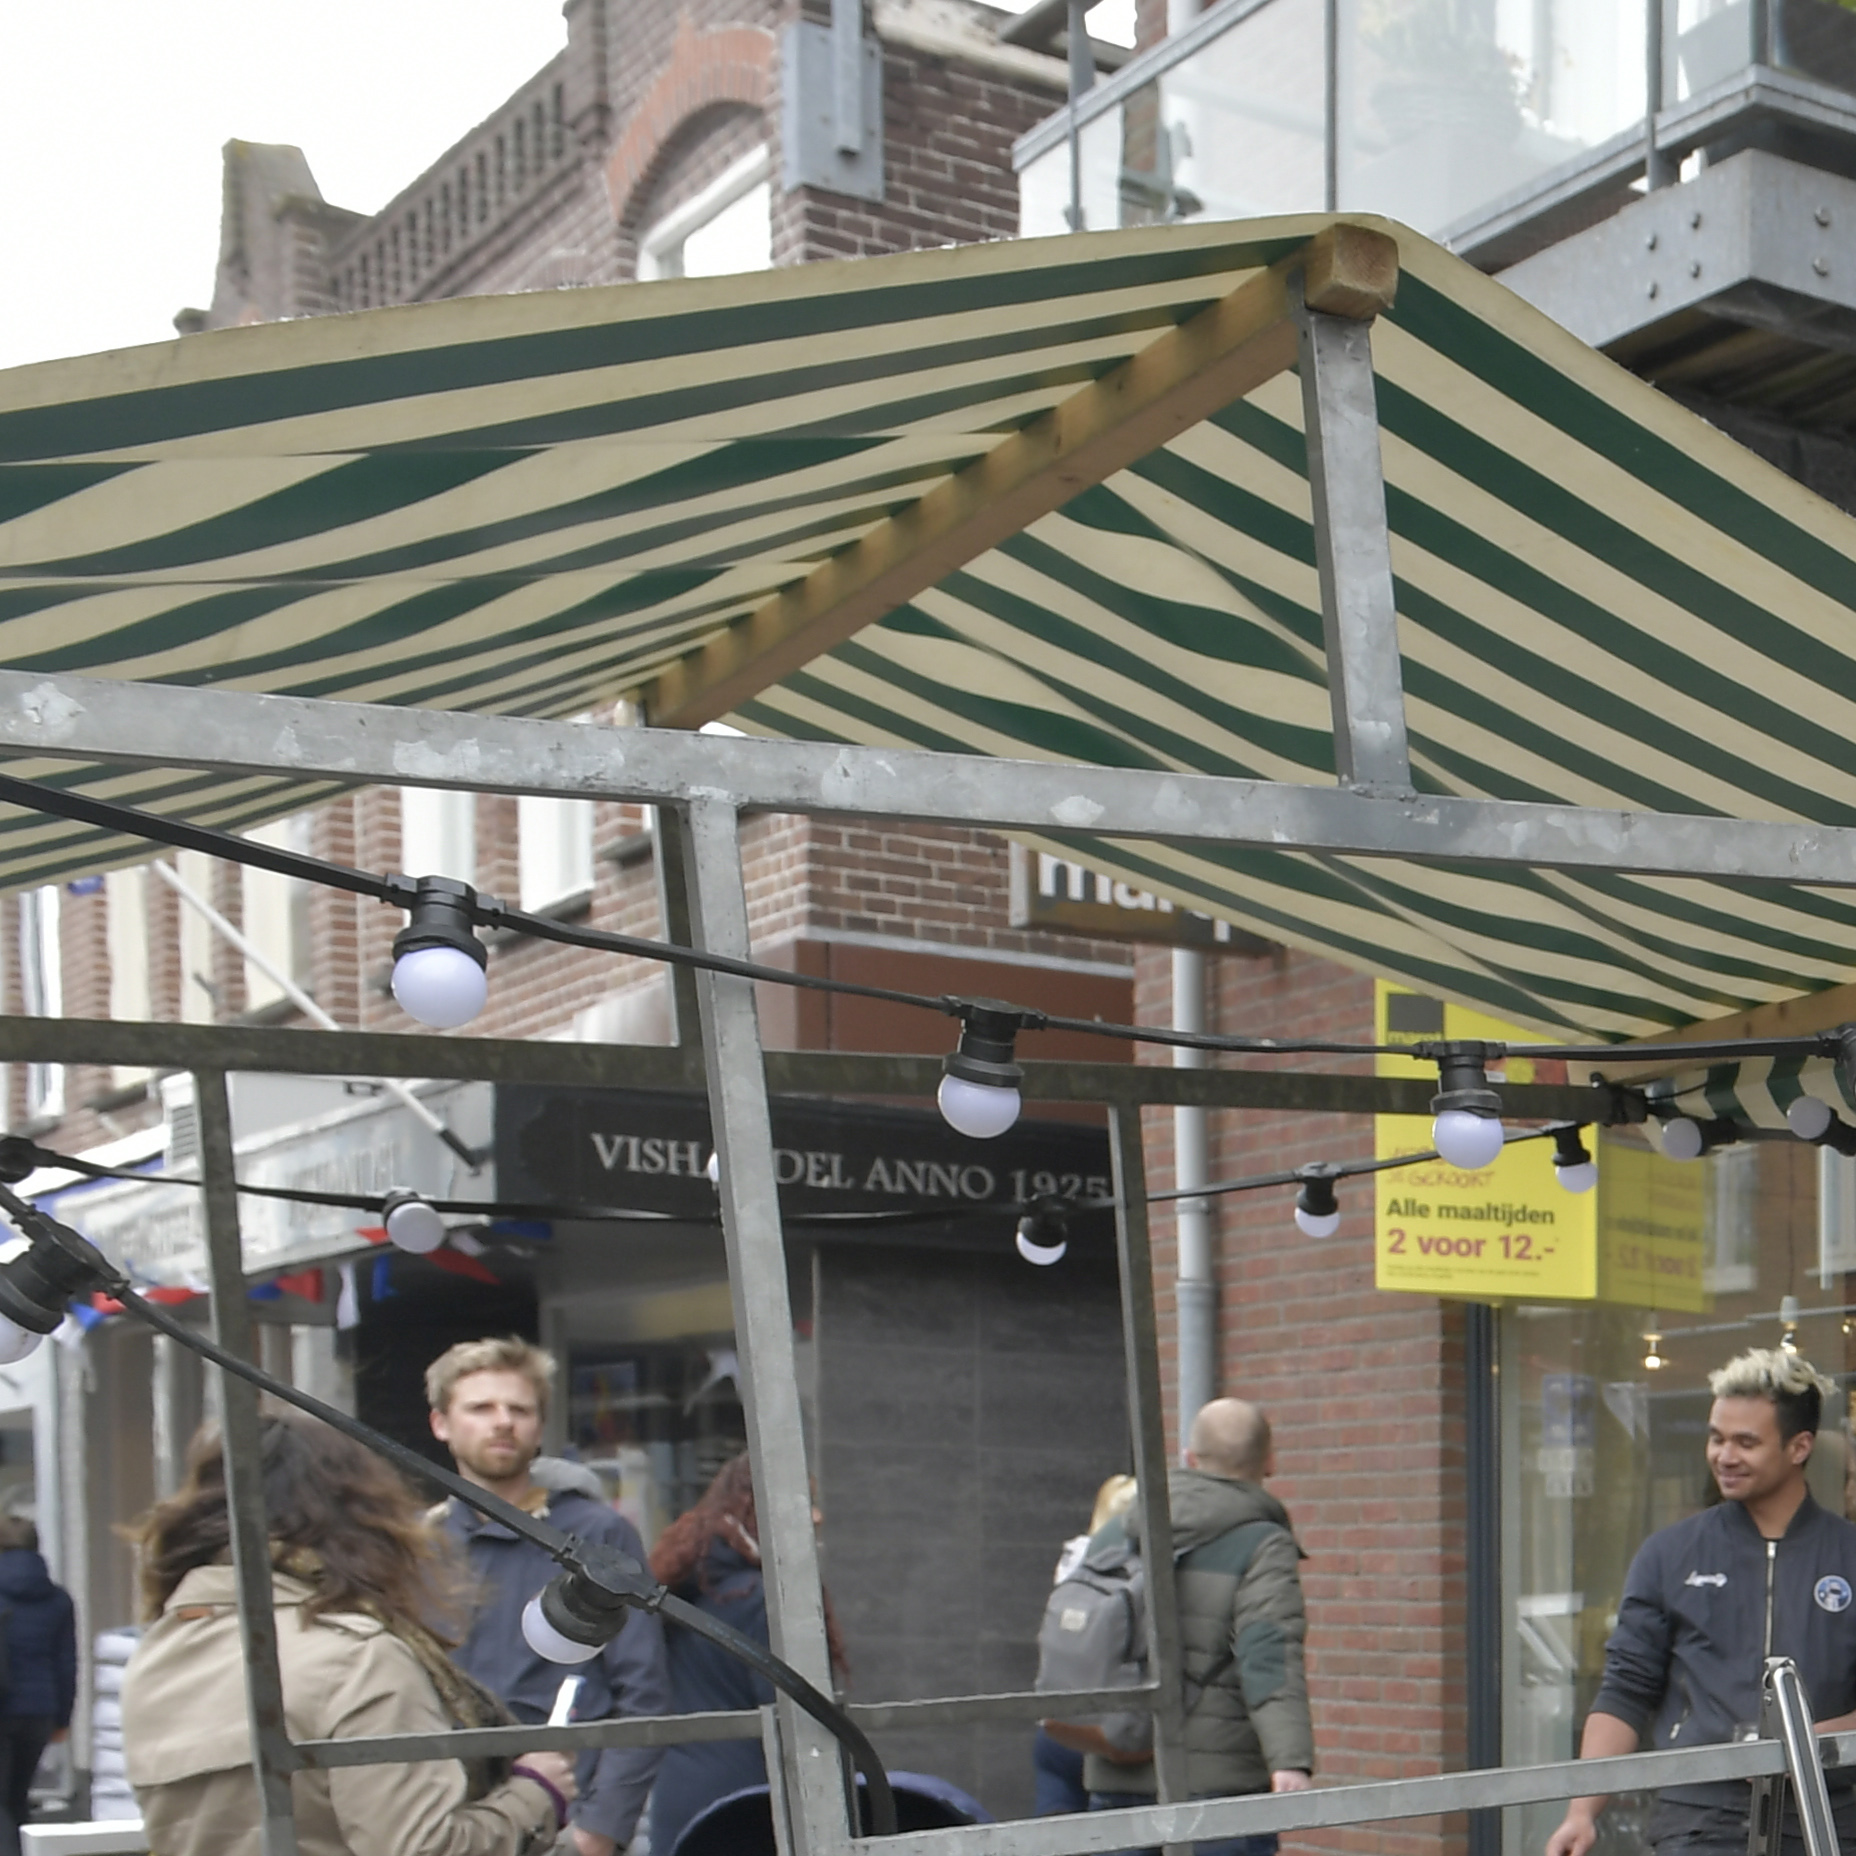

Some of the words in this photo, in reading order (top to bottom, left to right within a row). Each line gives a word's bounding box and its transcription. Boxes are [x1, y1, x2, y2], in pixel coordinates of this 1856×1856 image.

[590, 1132, 855, 1190] VISHDEL
[863, 1155, 995, 1200] ANNO
[1386, 1199, 1431, 1218] Alle
[1437, 1203, 1555, 1227] maaltijden
[1387, 1228, 1406, 1254] 2
[1417, 1235, 1486, 1257] voor
